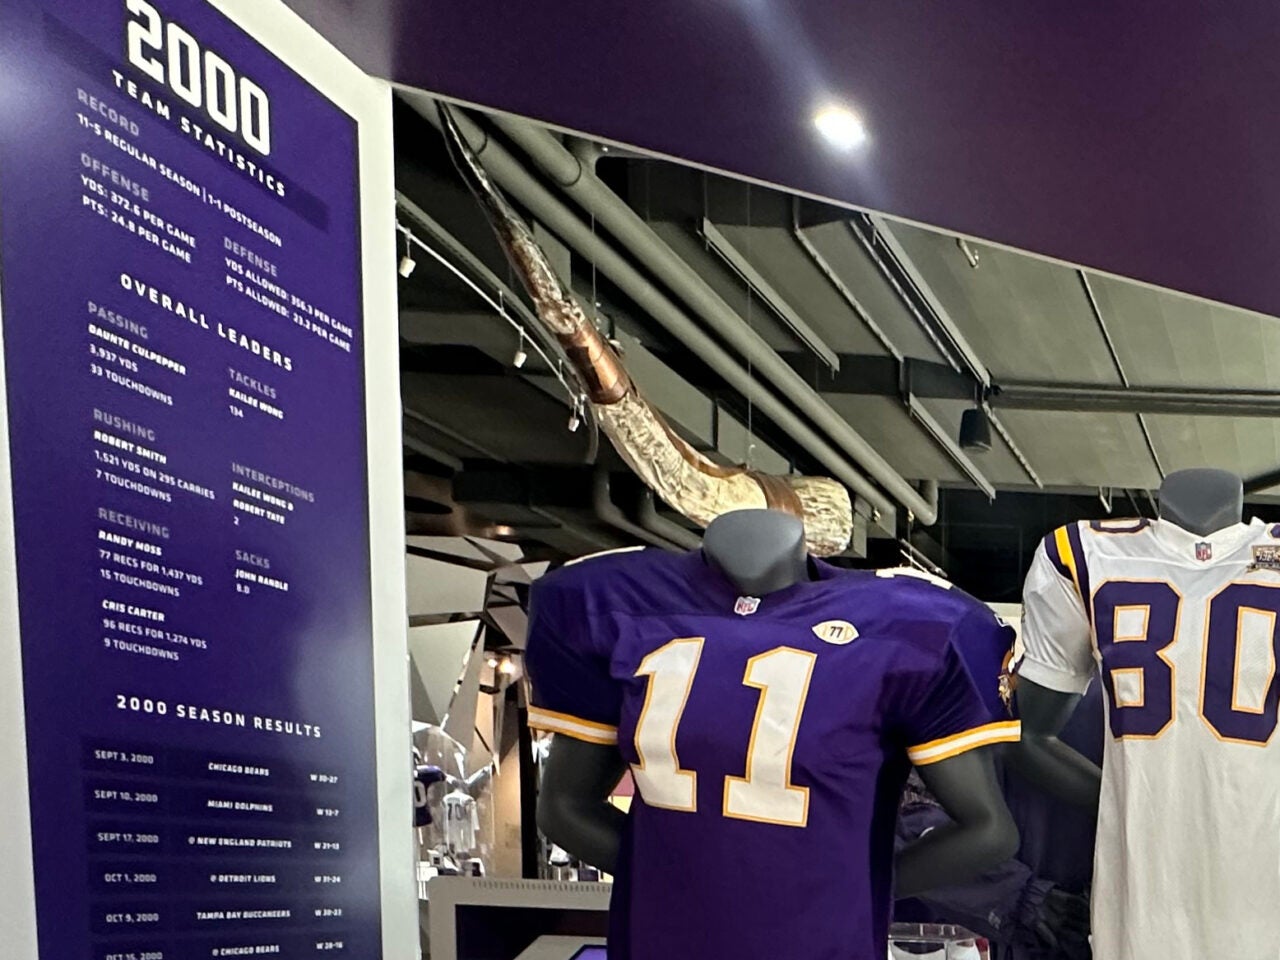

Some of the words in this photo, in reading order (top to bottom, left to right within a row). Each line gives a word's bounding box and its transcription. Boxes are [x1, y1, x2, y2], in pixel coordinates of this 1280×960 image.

[126, 0, 270, 156] 2000
[77, 88, 139, 137] RECORD
[112, 69, 170, 120] TEAM
[181, 116, 285, 197] STATISTICS
[77, 113, 101, 135] 11-5
[104, 129, 157, 170] REGULAR
[159, 163, 200, 196] SEASON
[208, 194, 222, 210] 1-1
[223, 203, 282, 247] POSTSEASON
[80, 153, 149, 202] OFFENSE
[80, 175, 108, 197] YDS:
[111, 191, 141, 216] 372.6
[143, 209, 164, 230] PER
[166, 223, 196, 248] GAME
[82, 195, 108, 217] PTS:
[111, 211, 135, 232] 24.8
[138, 225, 159, 246] PER
[161, 239, 191, 263] GAME
[224, 237, 277, 277] DEFENSE
[87, 300, 148, 339] PASSING
[120, 274, 209, 329] OVERALL
[217, 322, 292, 371] LEADERS
[88, 324, 130, 350] DAUNTE
[131, 343, 186, 375] CULPEPPER
[89, 343, 117, 362] 3,937
[118, 356, 138, 372] YDS
[90, 364, 103, 376] 33
[105, 369, 173, 406] TOUCHDOWNS
[93, 408, 155, 442] RUSHING
[93, 430, 135, 452] ROBERT
[136, 445, 167, 464] SMITH
[98, 507, 169, 539] RECEIVING
[98, 530, 134, 547] RANDY
[135, 541, 162, 556] MOSS
[235, 568, 257, 582] JOHN
[257, 575, 288, 591] RANDLE
[102, 600, 126, 613] CRIS
[127, 605, 165, 622] CARTER
[829, 625, 844, 639] 77
[117, 694, 167, 715] 2000
[176, 704, 245, 727] SEASON
[253, 716, 321, 738] RESULTS
[630, 636, 818, 828] 11
[208, 762, 243, 773] CHICAGO
[244, 766, 269, 776] BEARS
